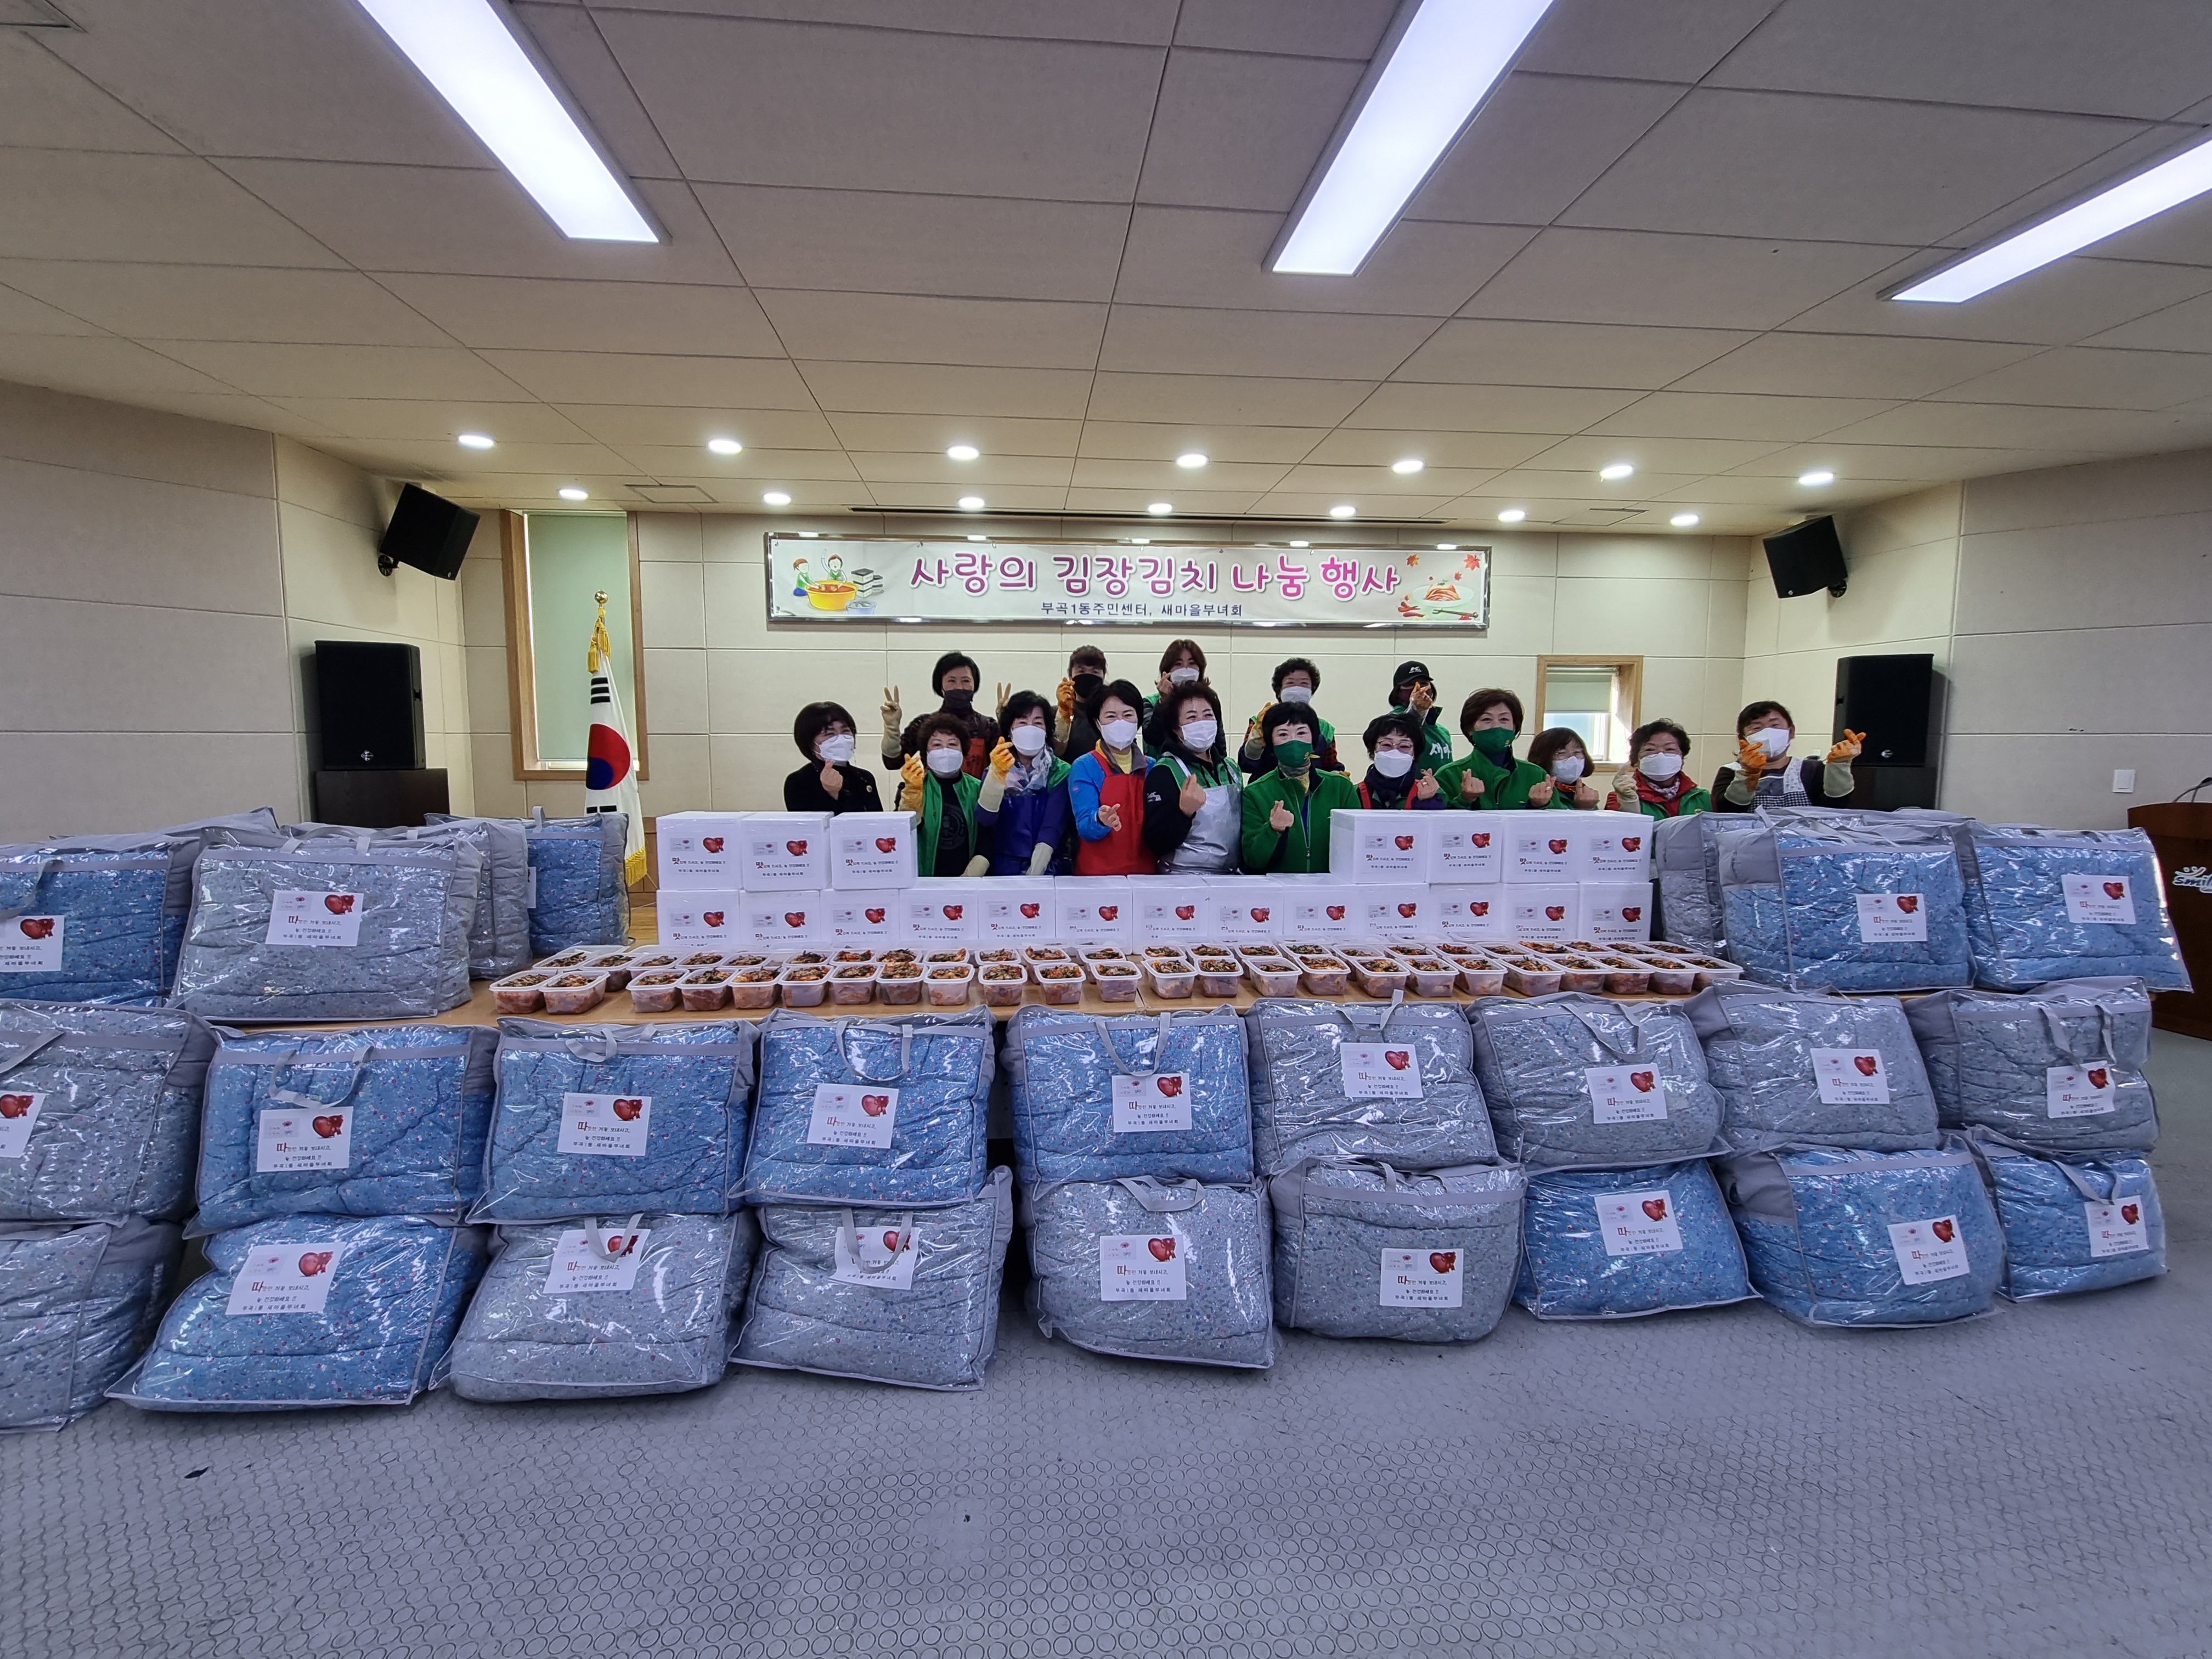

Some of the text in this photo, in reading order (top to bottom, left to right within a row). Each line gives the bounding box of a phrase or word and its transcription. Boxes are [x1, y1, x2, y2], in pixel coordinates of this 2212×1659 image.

[911, 552, 1398, 599] 사랑의 김장김치 나눔 행사
[1041, 602, 1243, 617] 부곡1동주민센터, 새마을부녀회
